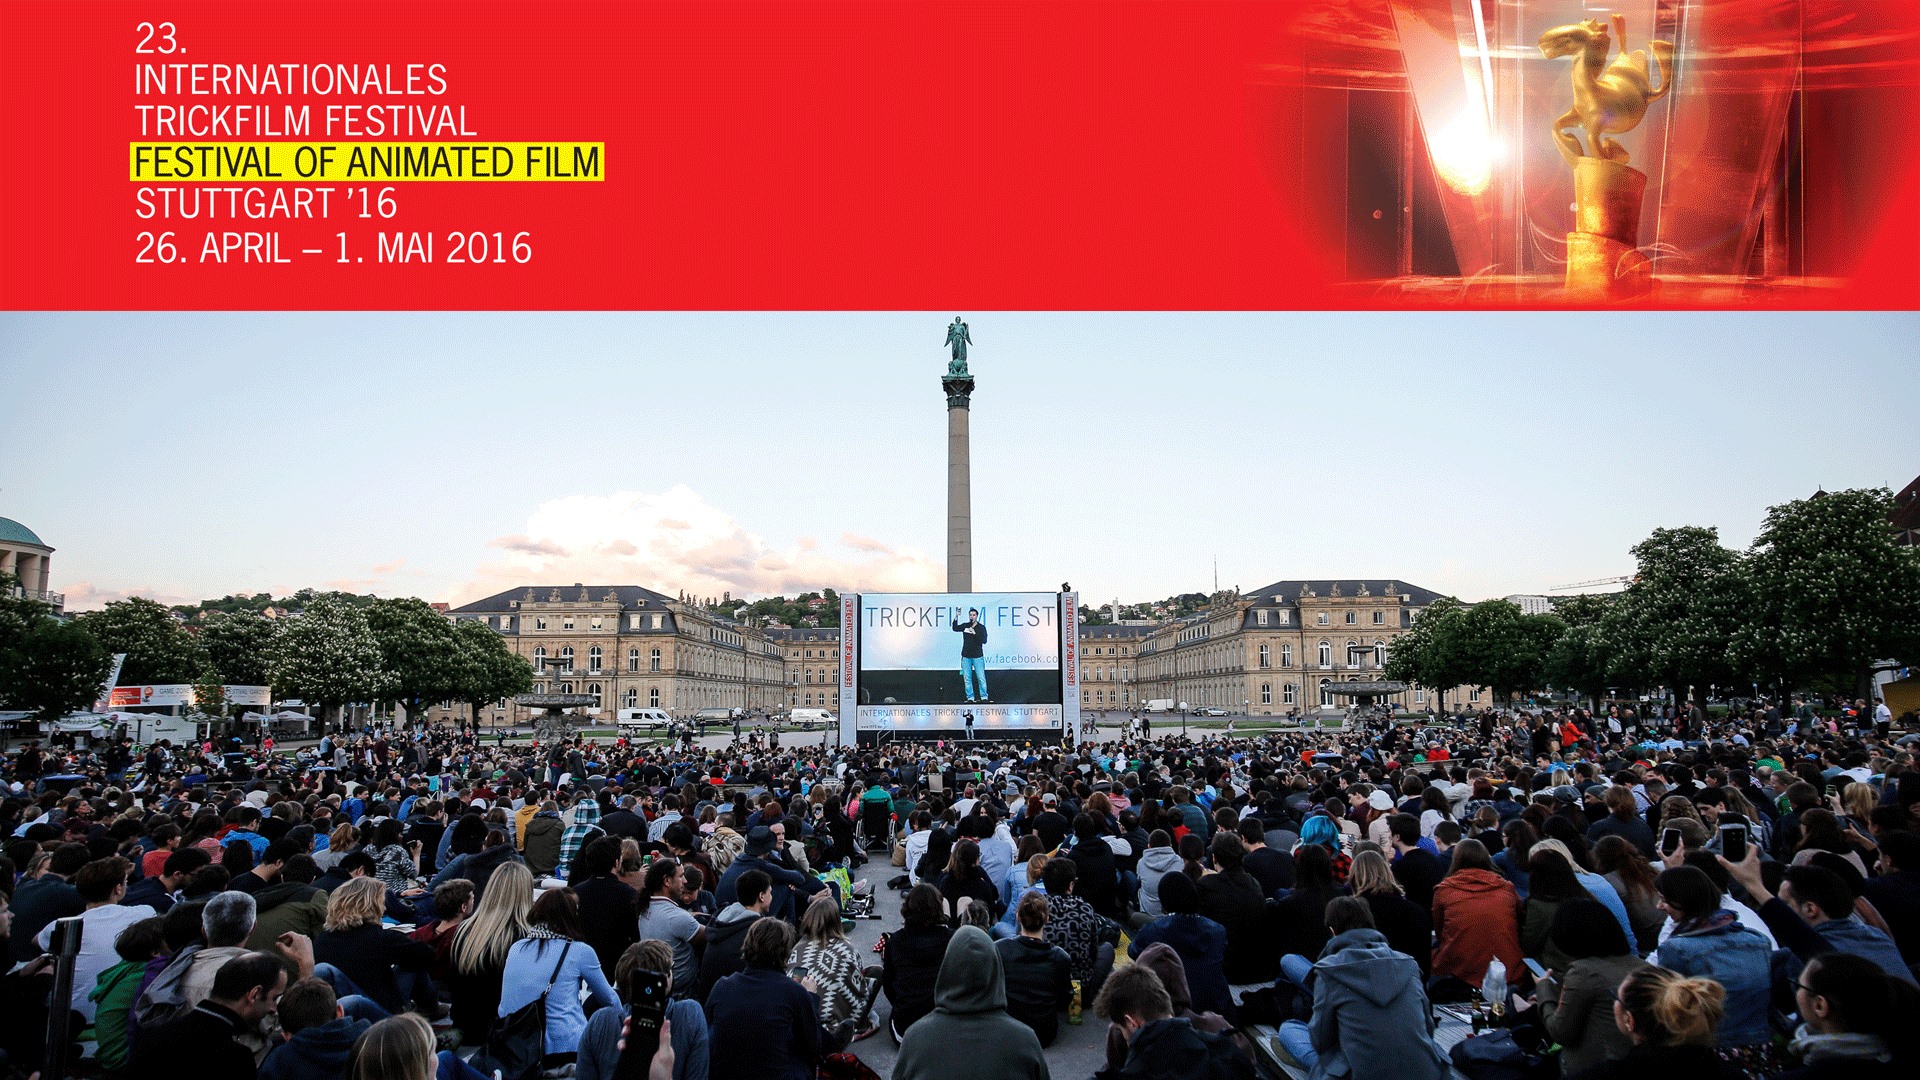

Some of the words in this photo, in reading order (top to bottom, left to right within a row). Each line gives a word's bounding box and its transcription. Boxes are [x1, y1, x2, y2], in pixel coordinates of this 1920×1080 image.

[845, 599, 853, 614] FILM
[998, 606, 1055, 627] FEST
[845, 648, 852, 657] OF
[1067, 646, 1074, 655] OF
[1067, 657, 1075, 685] FESTIVAL
[860, 708, 931, 717] INTERNATIONALES
[976, 708, 1010, 716] FESTIVAL
[1014, 708, 1058, 716] STUTTGART
